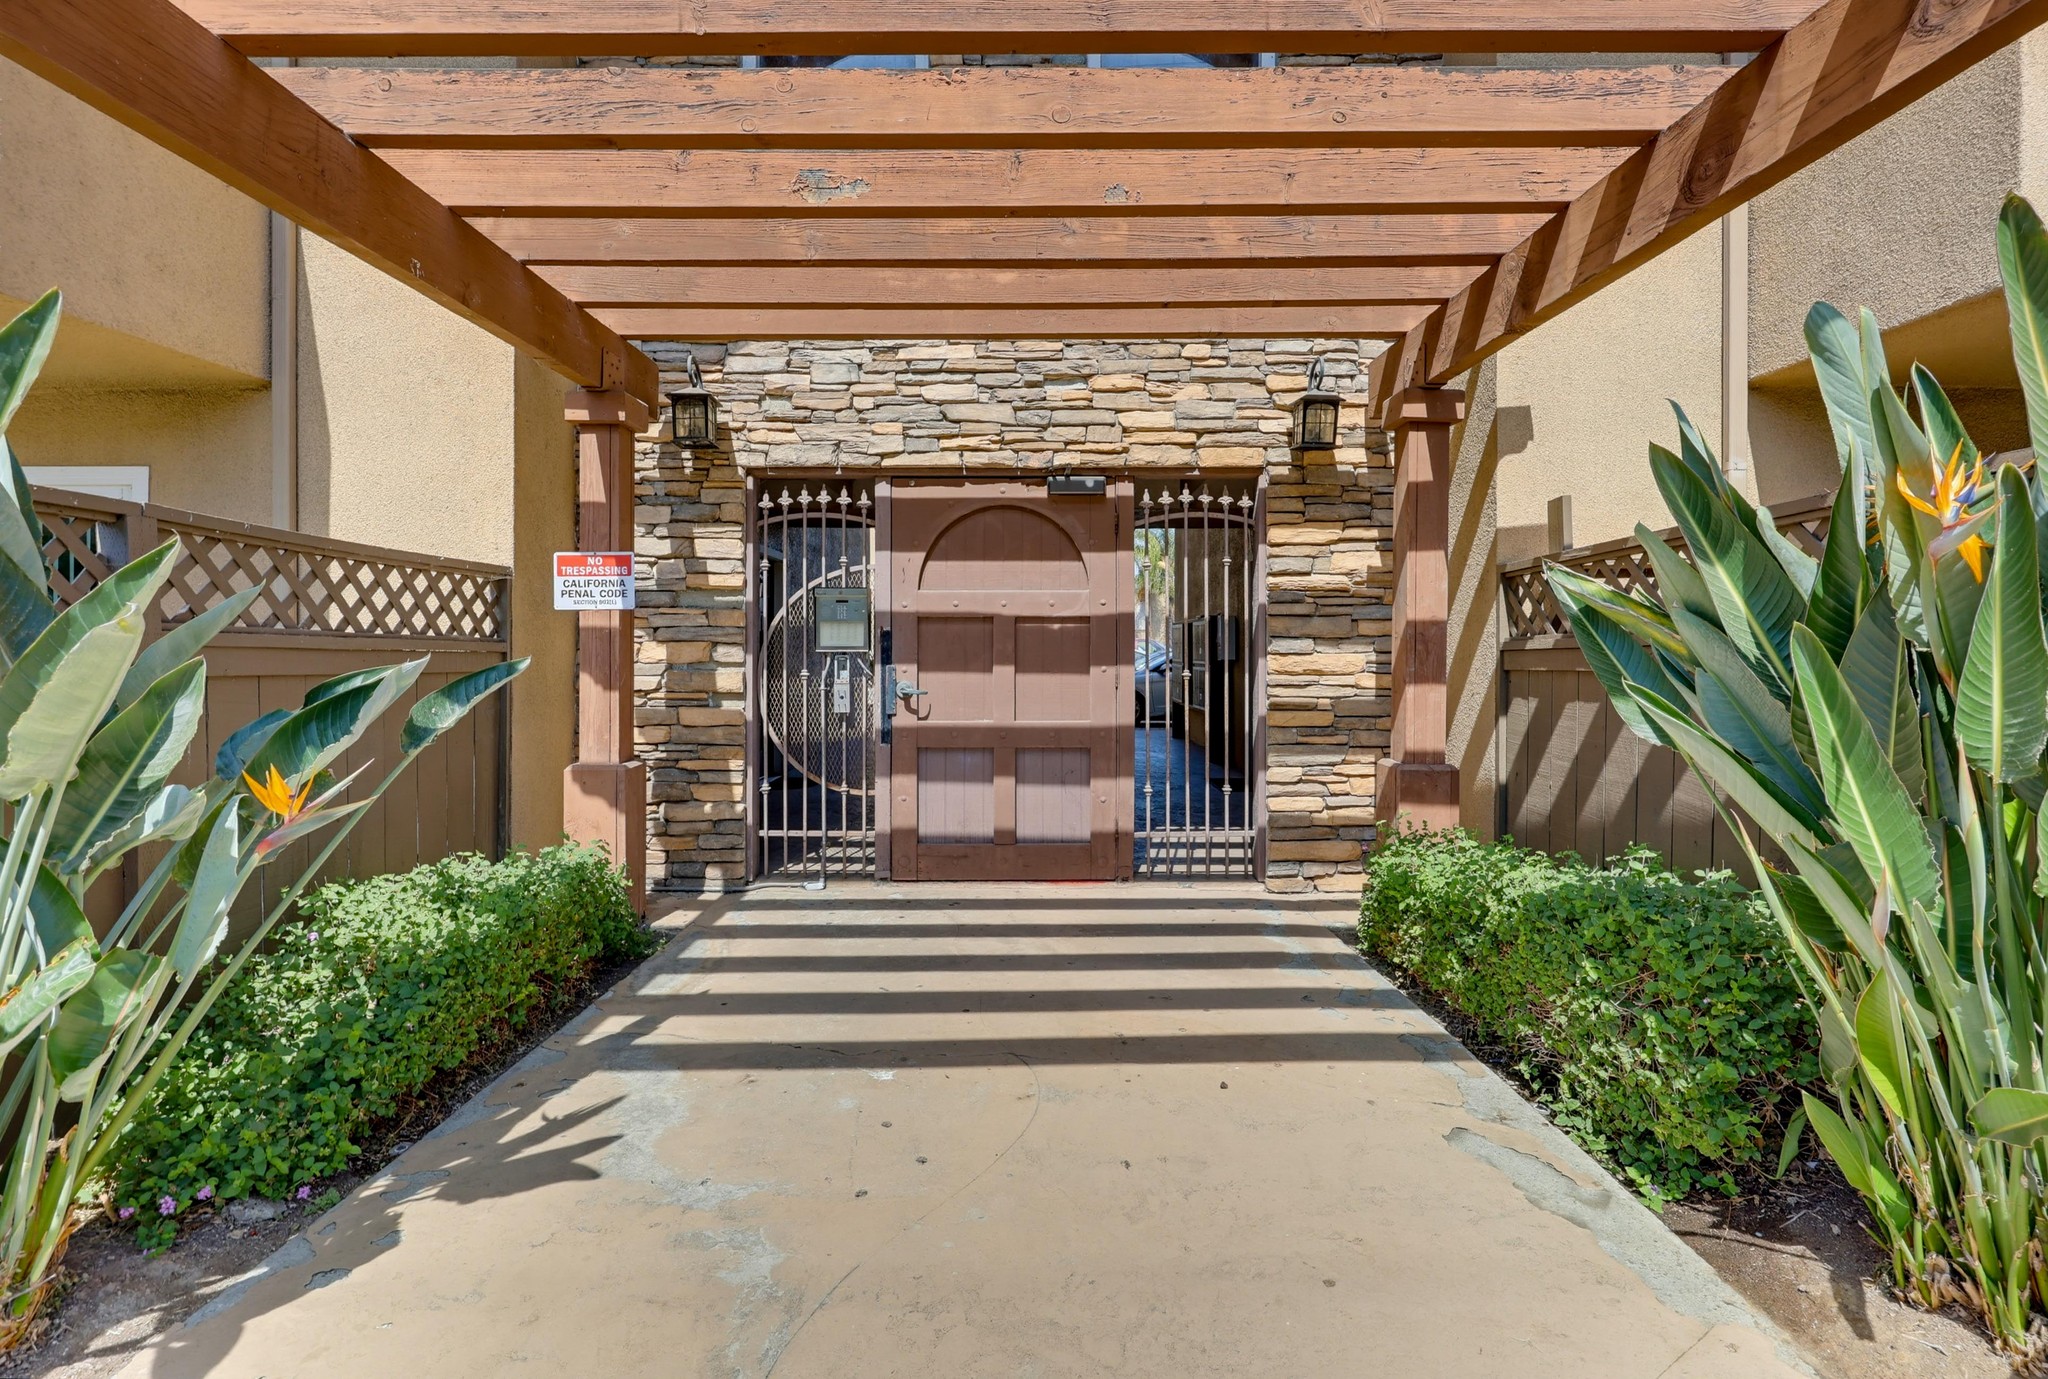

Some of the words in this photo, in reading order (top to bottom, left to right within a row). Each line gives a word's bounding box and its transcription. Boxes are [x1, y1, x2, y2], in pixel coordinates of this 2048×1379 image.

[587, 556, 603, 565] NO
[560, 566, 628, 575] TRESPASSING
[563, 579, 626, 588] CALIFORNIA
[561, 589, 596, 598] PENAL
[599, 589, 628, 598] CODE
